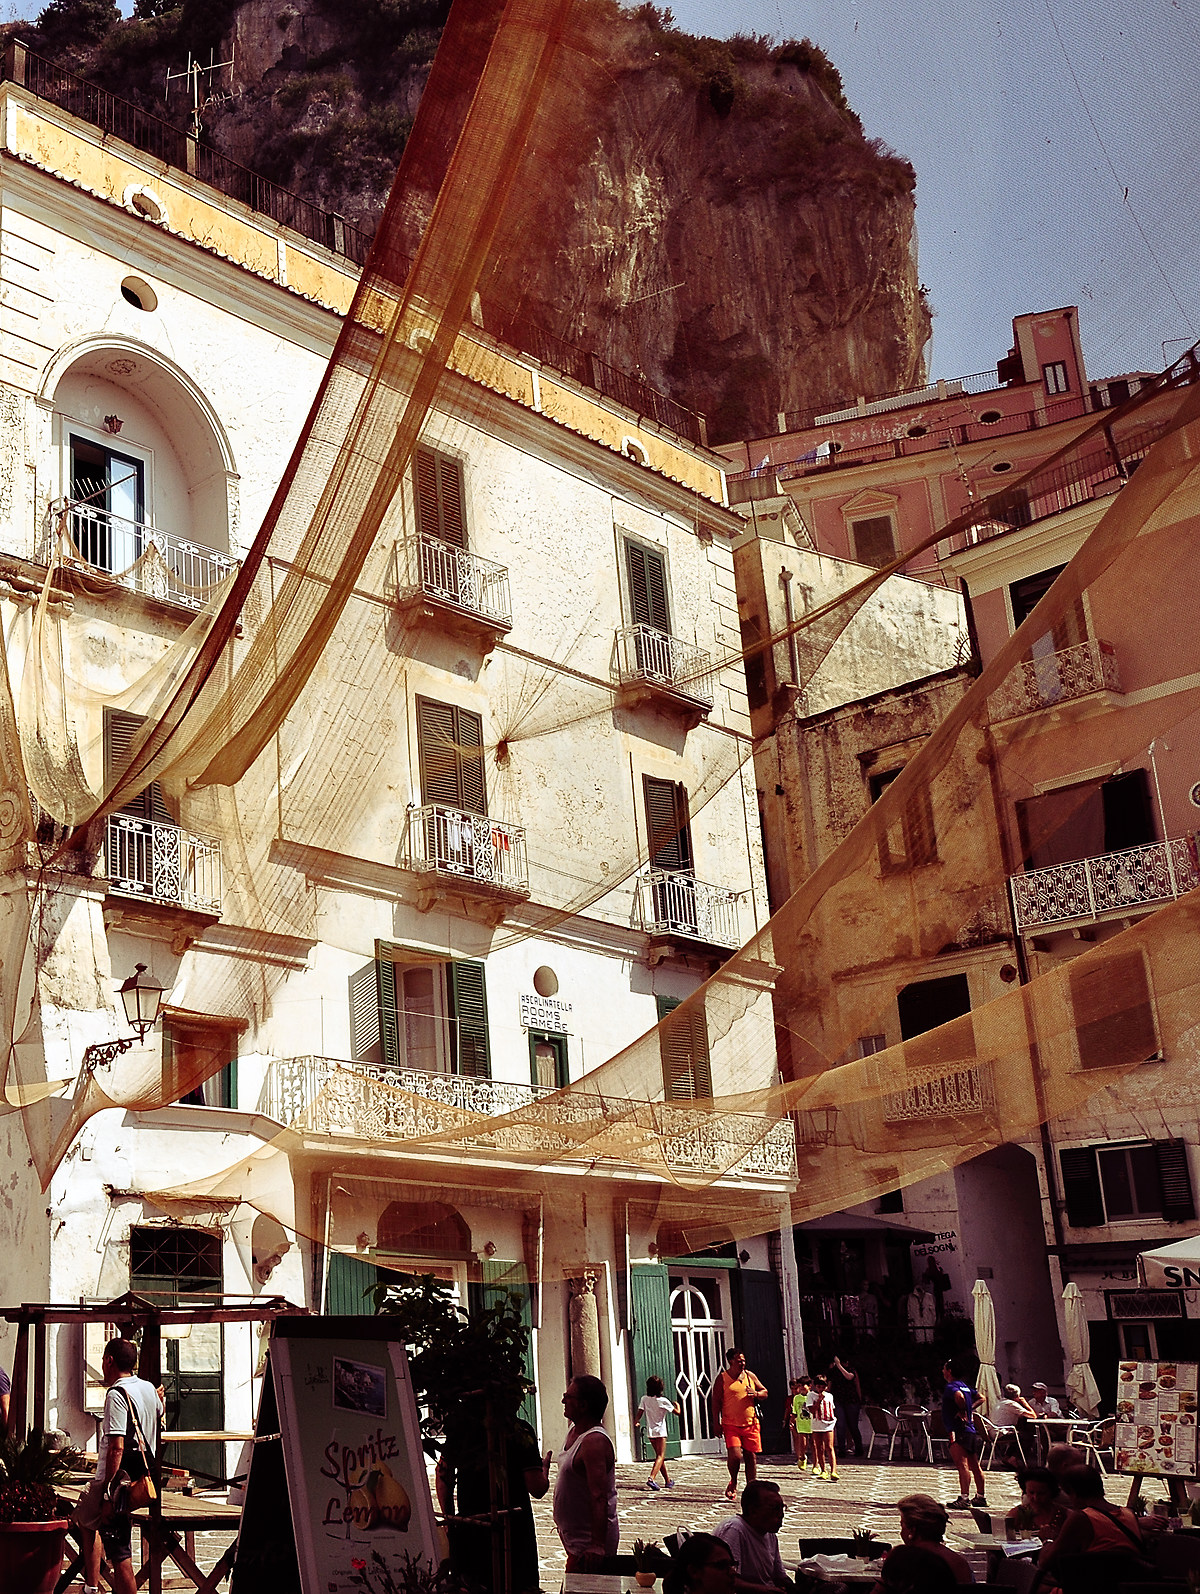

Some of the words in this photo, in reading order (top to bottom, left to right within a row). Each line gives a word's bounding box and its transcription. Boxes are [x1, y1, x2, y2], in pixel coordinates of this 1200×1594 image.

[522, 1005, 561, 1021] ROOMS
[523, 1016, 569, 1032] CAMERE
[320, 1428, 400, 1490] Spritz
[322, 1497, 408, 1526] Lemon
